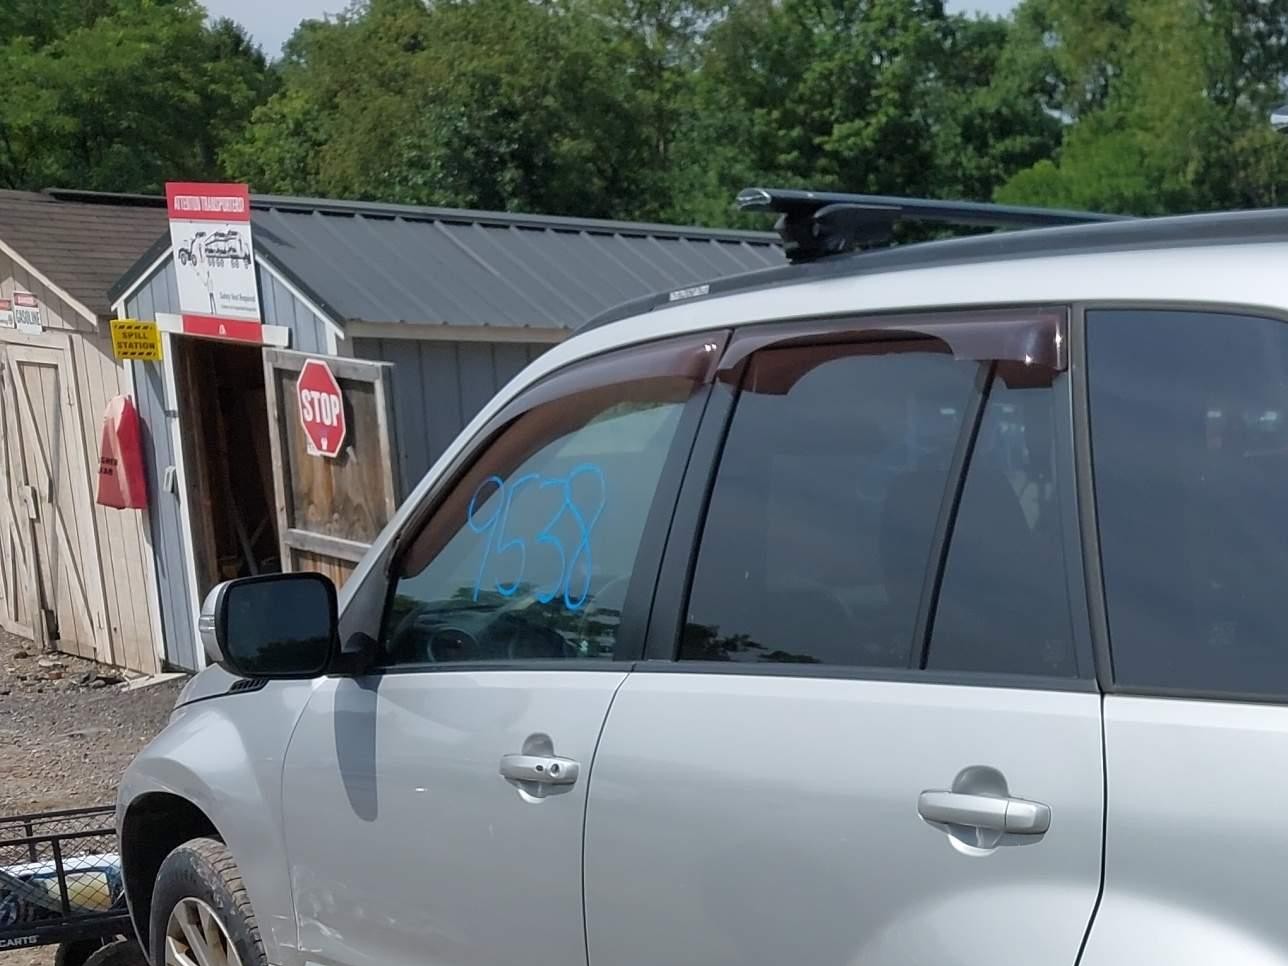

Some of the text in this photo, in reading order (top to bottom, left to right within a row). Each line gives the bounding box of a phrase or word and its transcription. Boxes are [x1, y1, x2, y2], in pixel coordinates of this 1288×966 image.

[15, 309, 40, 326] GASOLINE
[122, 331, 149, 340] SPILL
[117, 341, 155, 350] STATION
[301, 388, 340, 427] STOP
[467, 463, 606, 612] 9538
